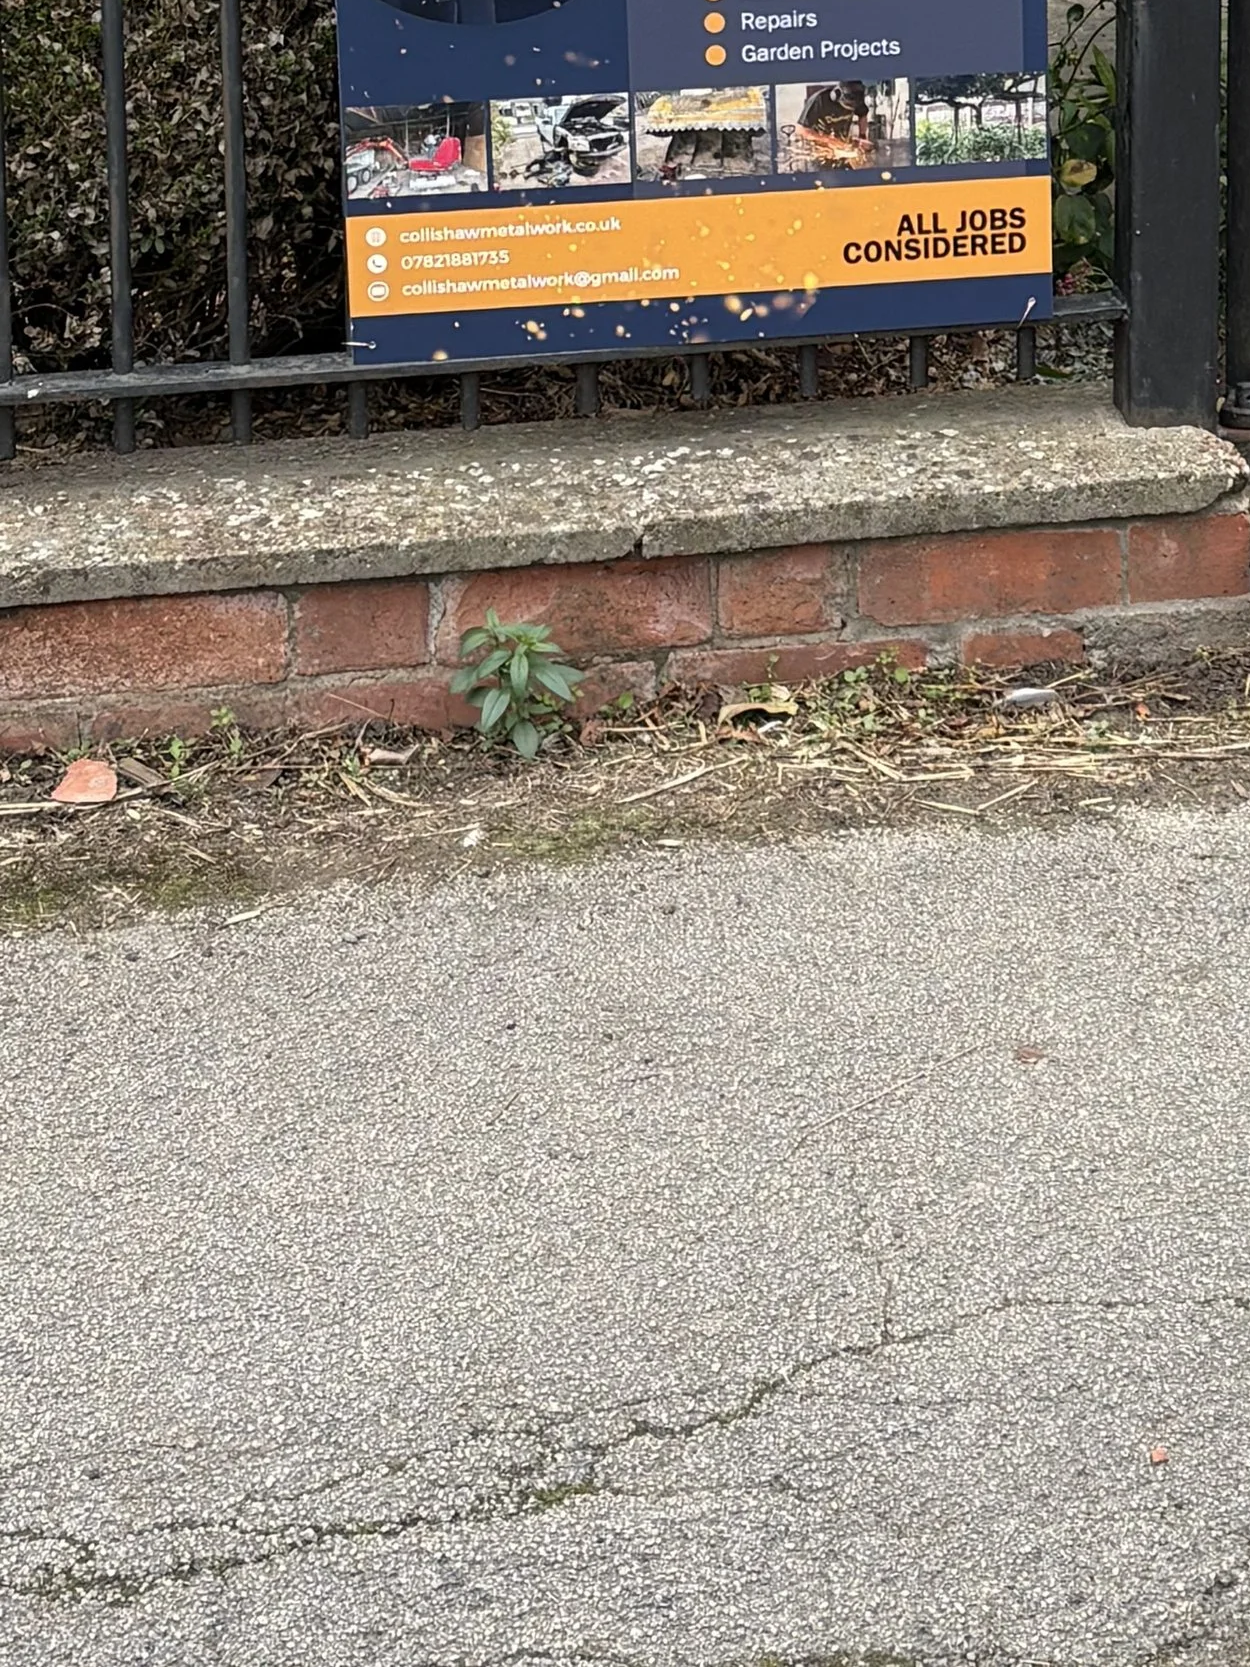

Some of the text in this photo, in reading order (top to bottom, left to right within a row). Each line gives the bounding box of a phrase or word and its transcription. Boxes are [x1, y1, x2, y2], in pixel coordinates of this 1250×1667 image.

[741, 10, 818, 33] Repairs
[741, 38, 901, 63] Garden Projects
[399, 217, 621, 243] collishawmetalwork.co.uk
[897, 207, 1027, 236] ALL JOBS
[400, 249, 511, 270] 07821881735
[843, 232, 1026, 264] CONSIDERED
[401, 266, 680, 297] collishawmetalwork@gmail.com
